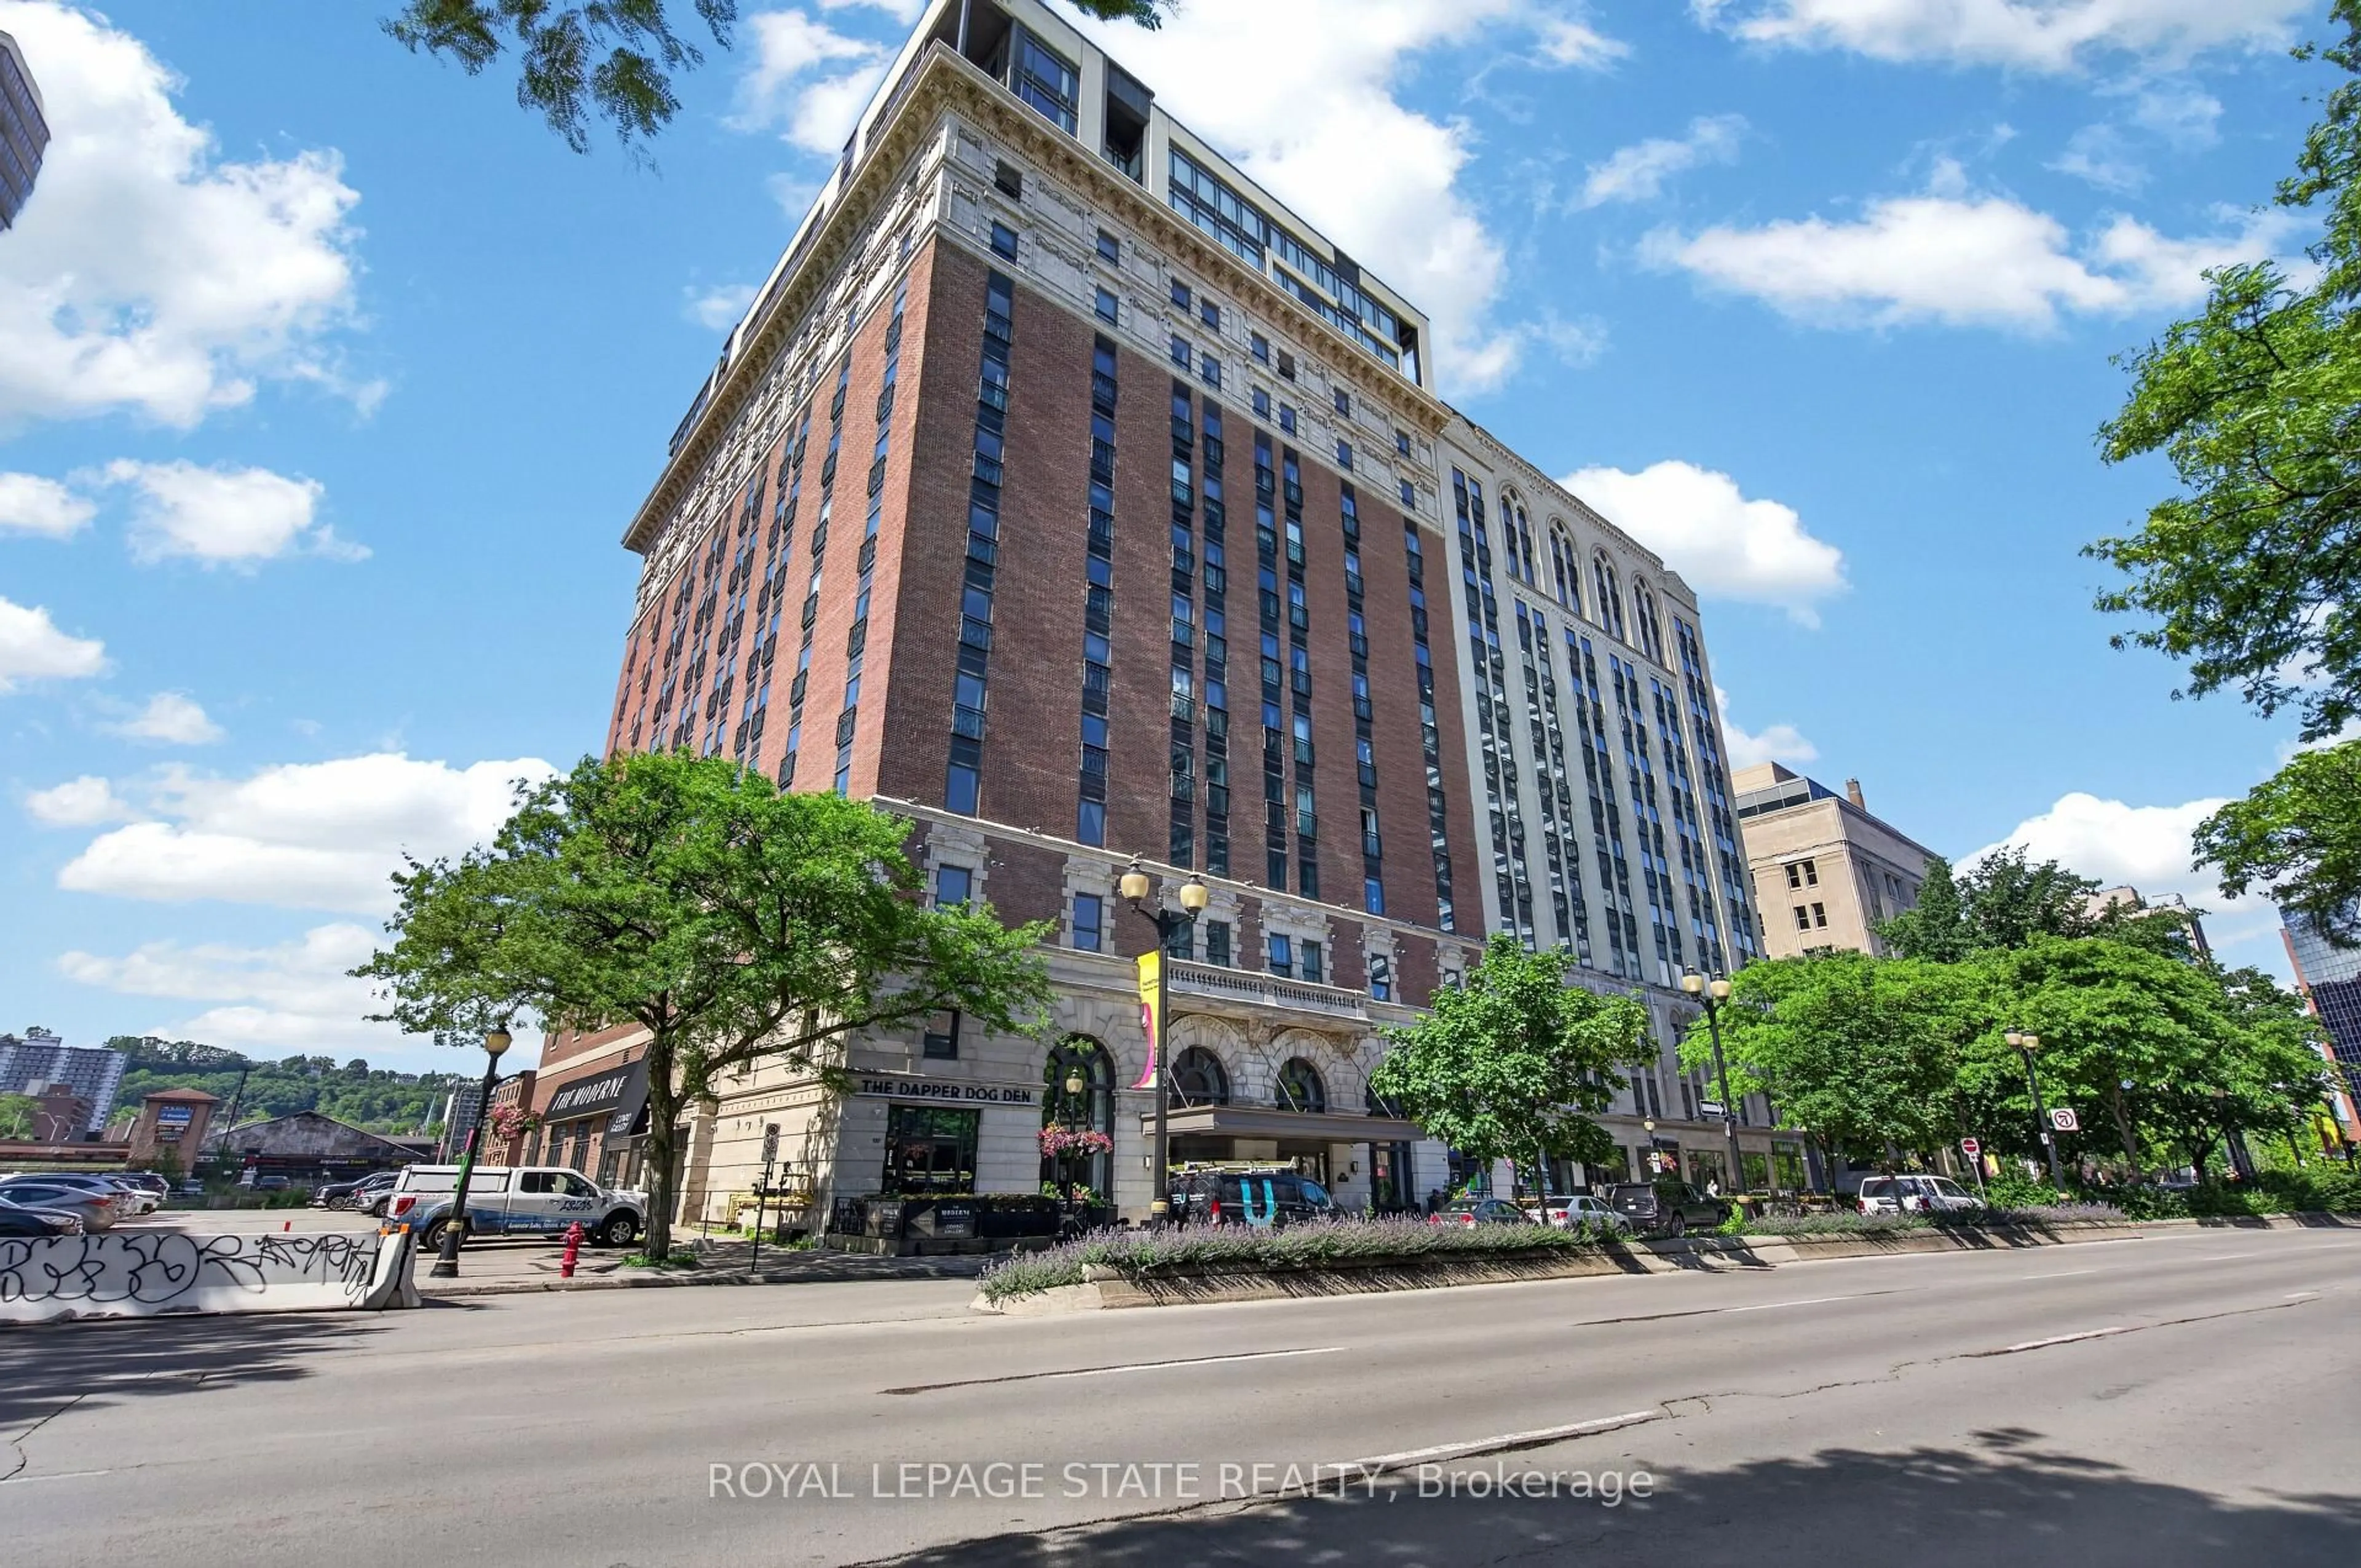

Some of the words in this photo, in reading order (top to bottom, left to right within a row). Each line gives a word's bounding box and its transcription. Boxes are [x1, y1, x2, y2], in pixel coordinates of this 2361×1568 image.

[552, 1089, 577, 1111] THE
[571, 1075, 628, 1106] MODERNE
[862, 1080, 893, 1094] THE
[900, 1082, 960, 1099] DAPPER
[965, 1087, 997, 1101] DOG
[1003, 1090, 1031, 1103] DEN
